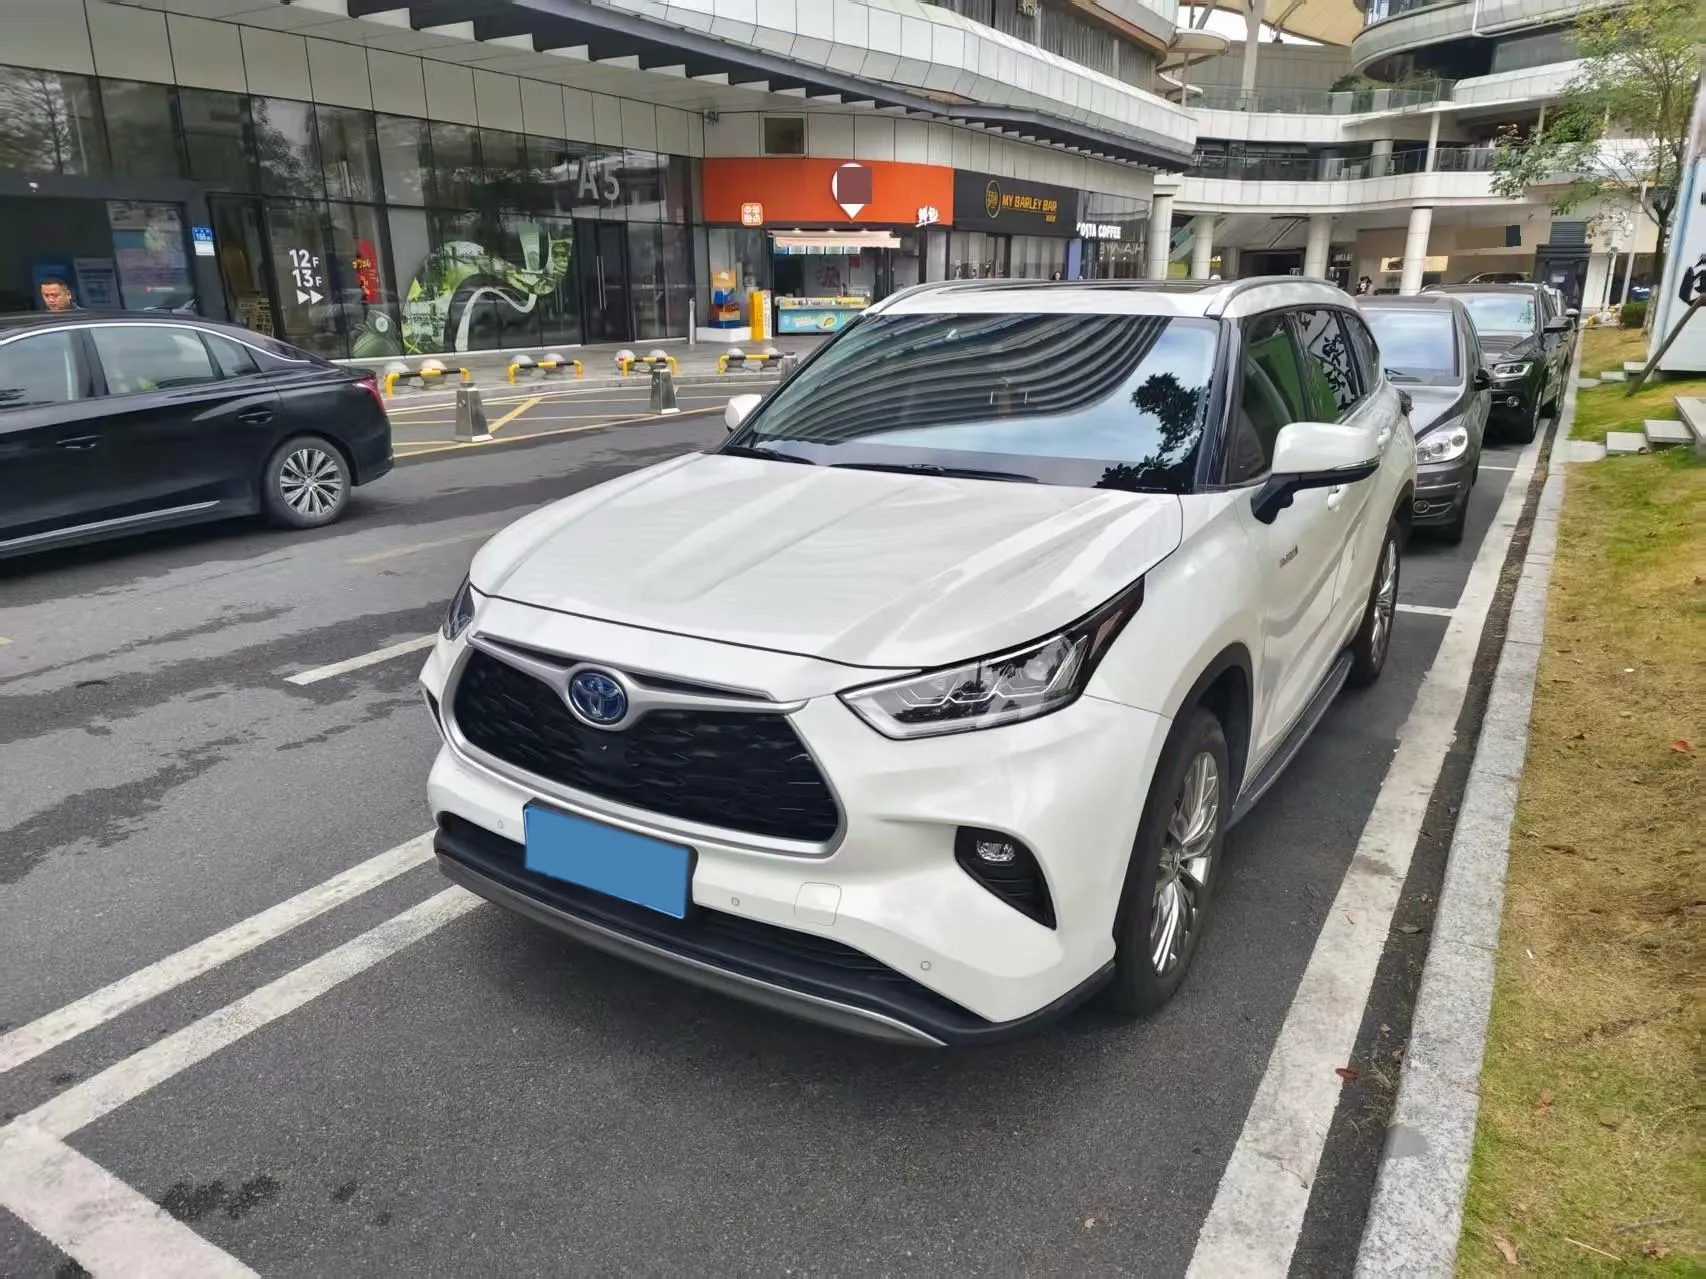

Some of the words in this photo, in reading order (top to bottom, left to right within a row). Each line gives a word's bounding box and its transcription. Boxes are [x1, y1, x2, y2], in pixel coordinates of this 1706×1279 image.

[578, 158, 619, 201] A5
[1002, 193, 1014, 207] MY
[1015, 196, 1042, 209] BARLEY
[1043, 200, 1057, 212] BAR
[1098, 224, 1121, 239] COFFEE
